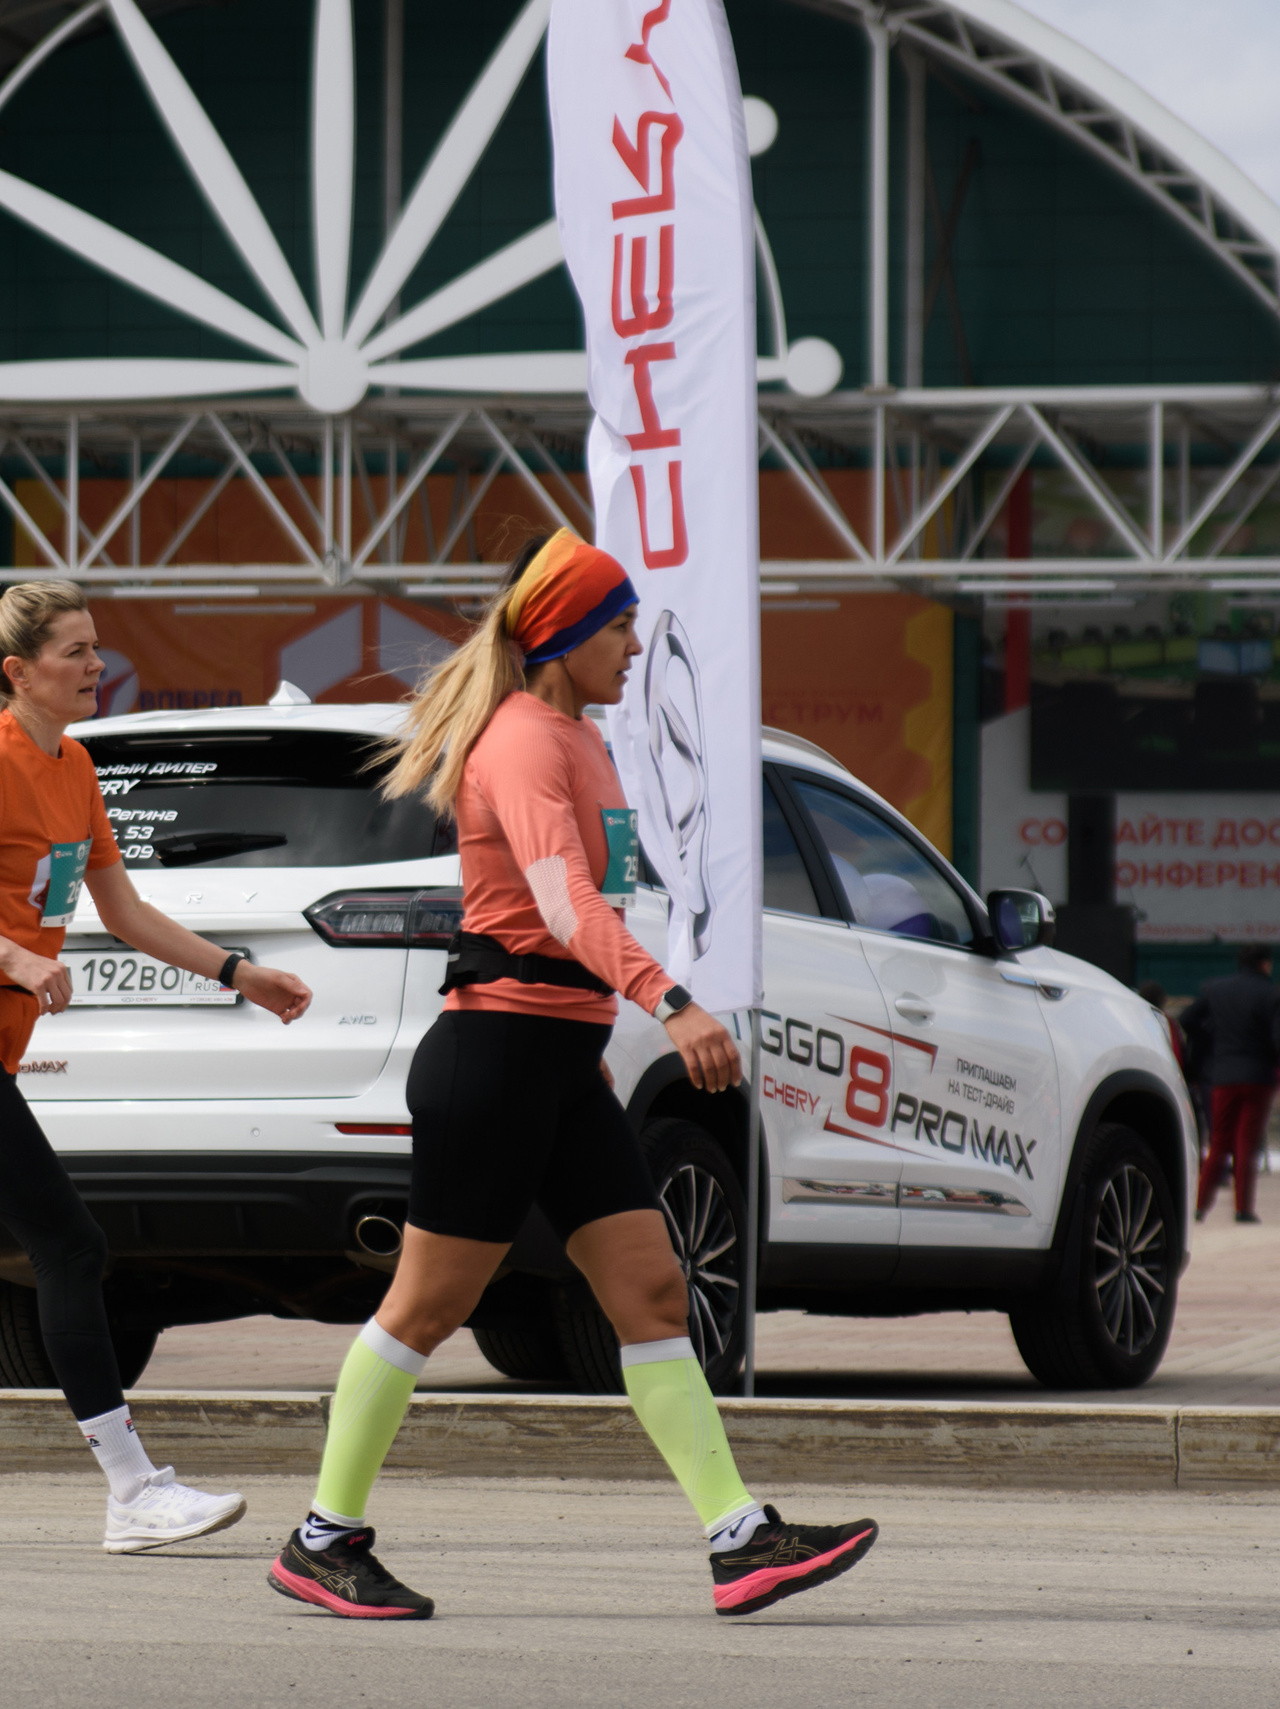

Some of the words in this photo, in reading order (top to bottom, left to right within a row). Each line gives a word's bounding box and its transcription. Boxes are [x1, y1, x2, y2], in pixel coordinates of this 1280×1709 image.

[94, 763, 149, 777] ЬНЫЙ
[149, 762, 218, 775] ДИЛЕР
[98, 779, 141, 796] ERY
[107, 808, 179, 822] Регина
[124, 825, 155, 840] 53
[1020, 814, 1206, 847] СОАЙТЕ
[120, 845, 154, 859] -09
[1116, 860, 1280, 889] ОНФЕРЕН
[338, 1014, 377, 1025] AWD
[845, 1045, 892, 1128] 8
[956, 1057, 1018, 1093] ПРИГЛАШАЕМ
[763, 1074, 822, 1116] CHERY
[947, 1078, 962, 1097] НА
[962, 1081, 1016, 1116] ТЕСТ-ДРАЙВ
